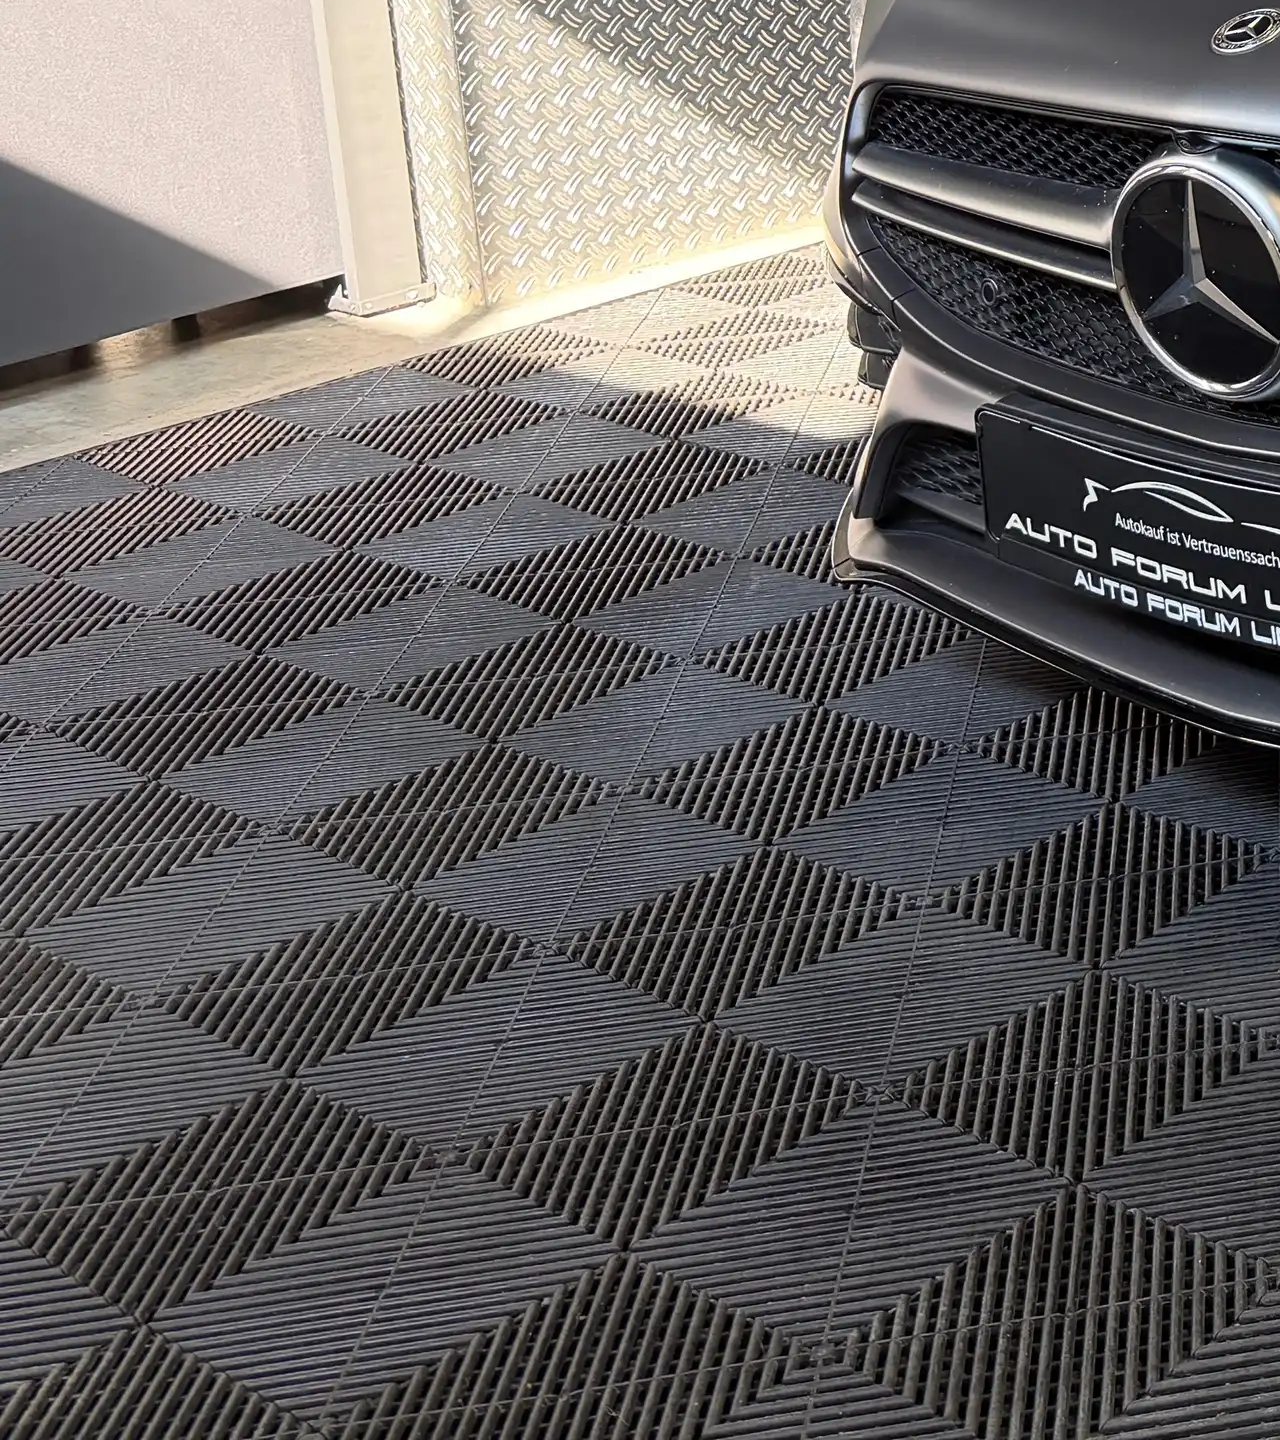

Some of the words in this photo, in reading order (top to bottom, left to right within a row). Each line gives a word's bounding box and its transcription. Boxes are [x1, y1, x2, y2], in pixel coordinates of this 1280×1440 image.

[1005, 513, 1098, 559] AUTO
[1111, 546, 1247, 605] FORUM
[1114, 512, 1165, 542] Autokauf
[1166, 525, 1182, 546] ist
[1074, 568, 1139, 607] AUTO
[1147, 592, 1241, 637] FORUM
